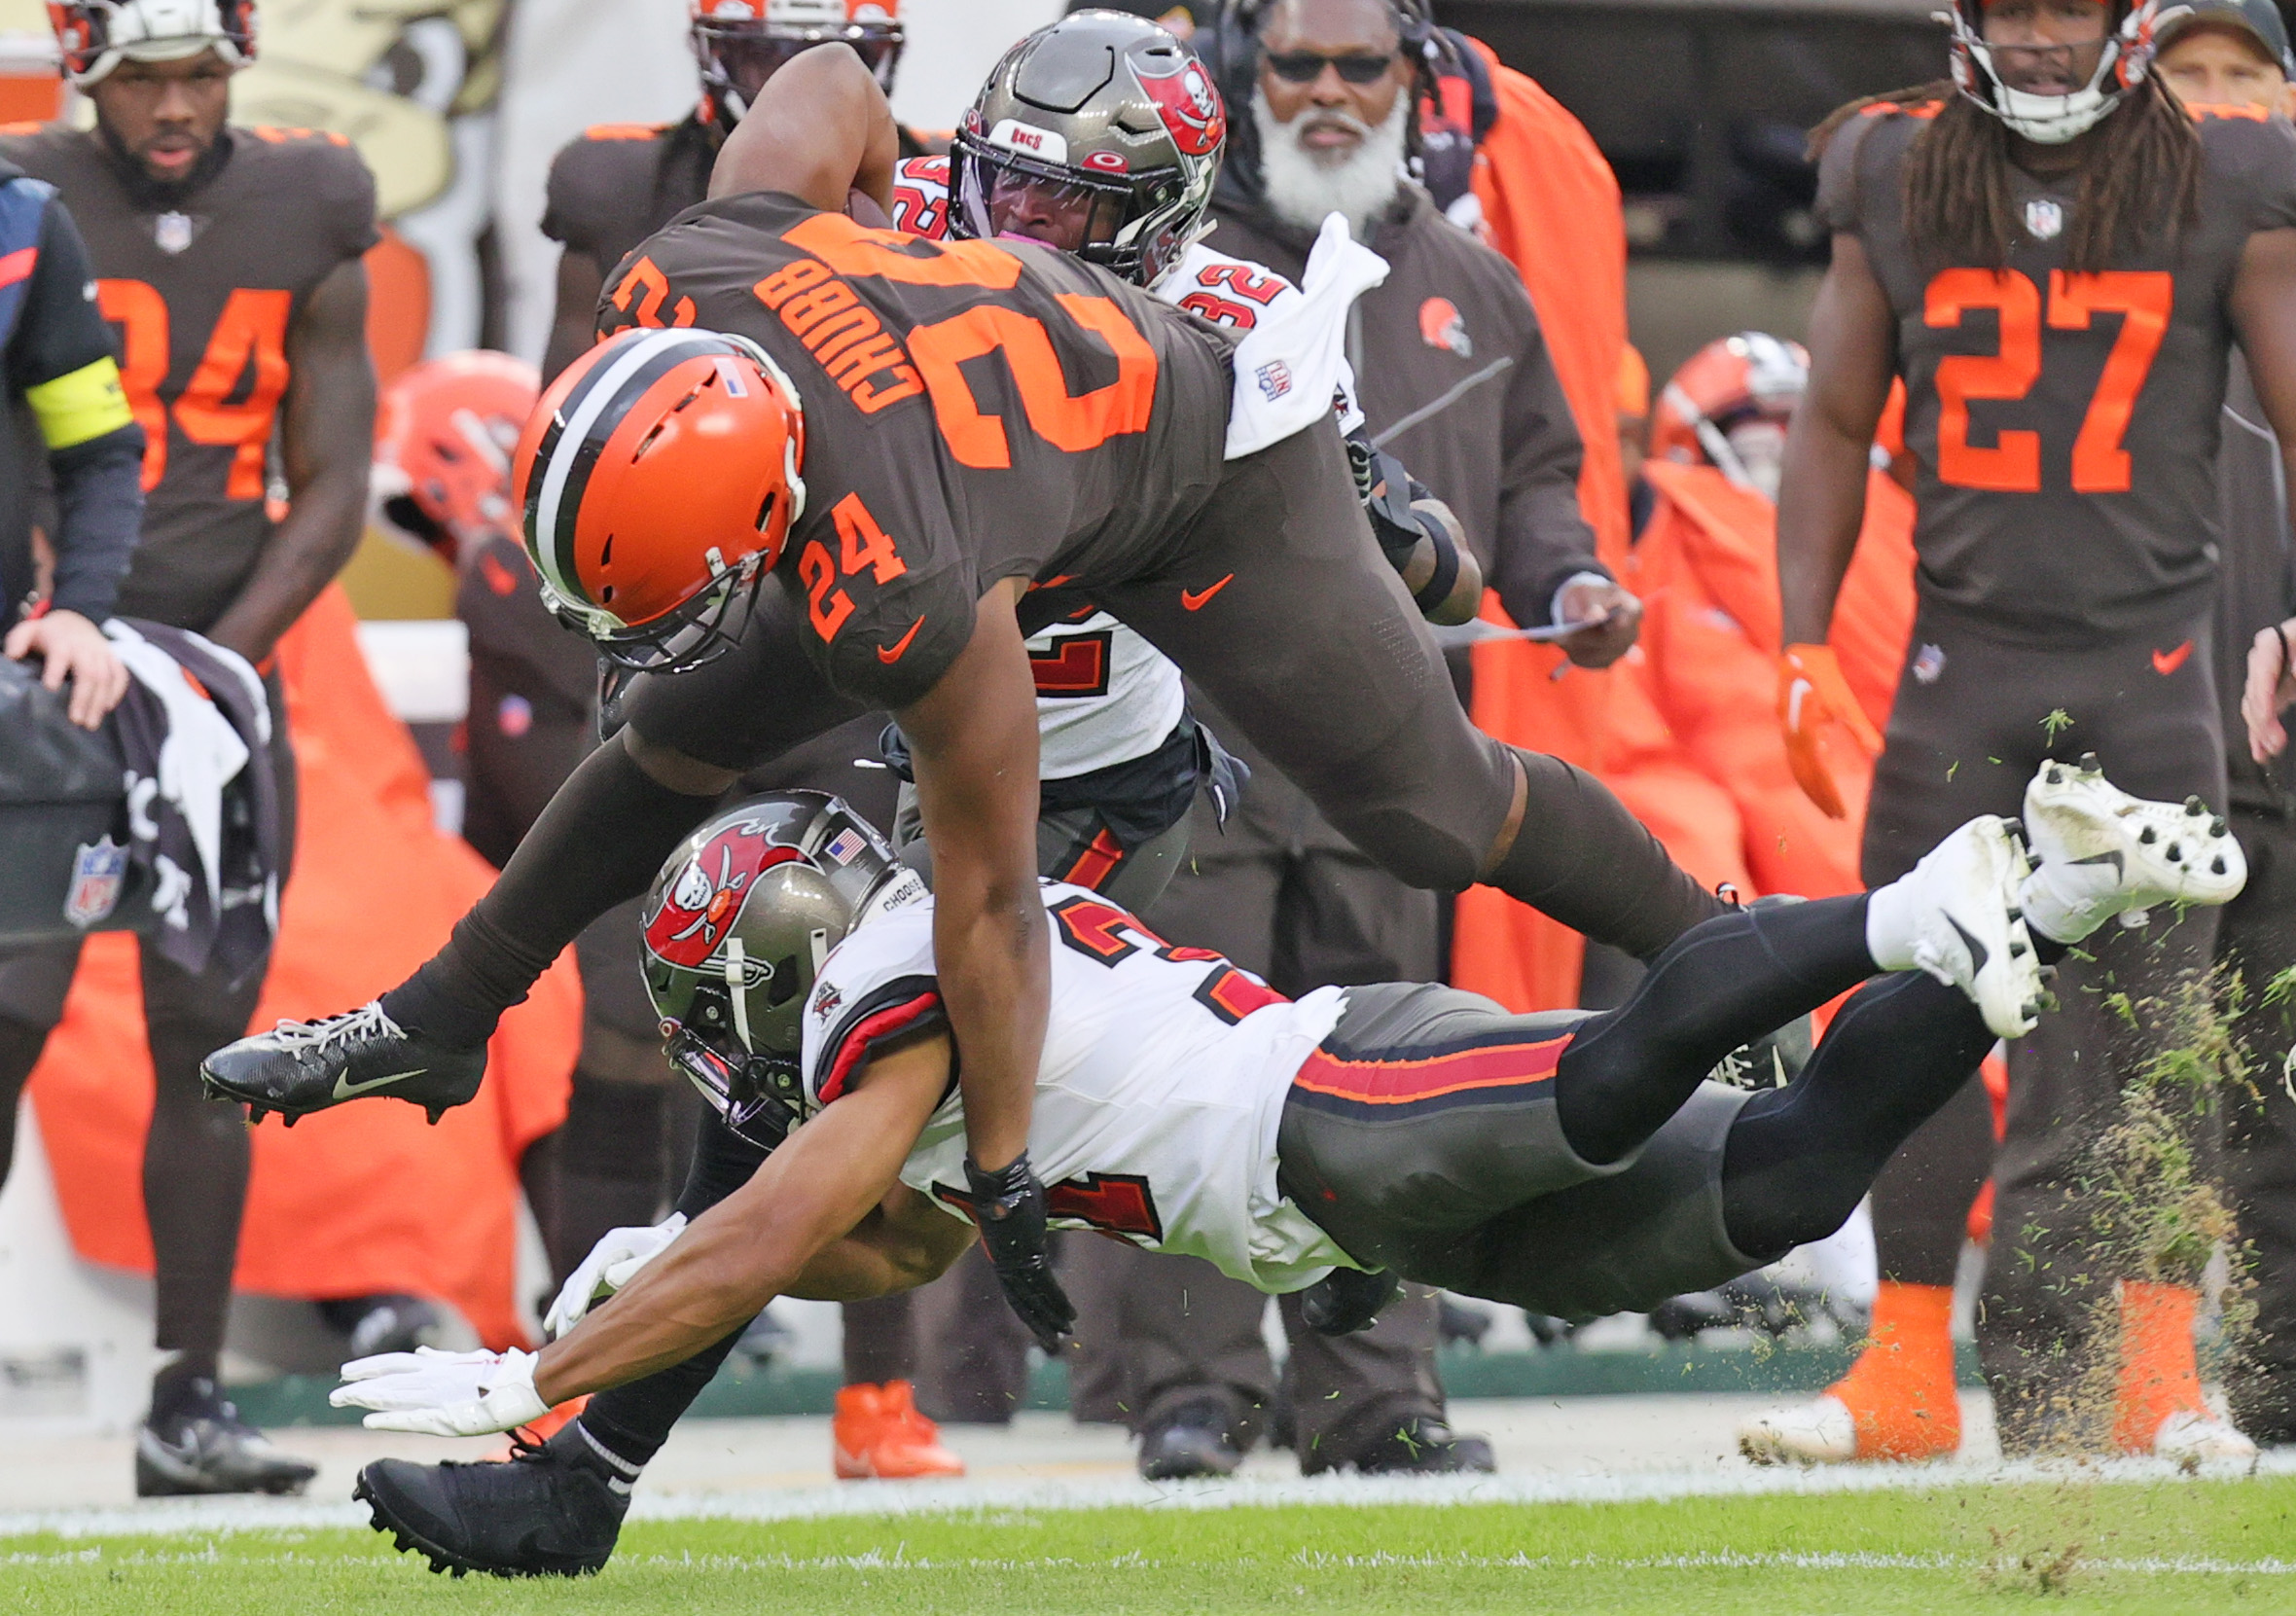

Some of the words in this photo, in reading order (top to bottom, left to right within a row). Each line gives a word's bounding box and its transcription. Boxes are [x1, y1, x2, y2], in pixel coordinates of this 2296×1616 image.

[753, 258, 925, 414] CHUBB
[1177, 264, 1289, 330] 32
[1923, 267, 2174, 493] 27
[798, 491, 908, 644] 24
